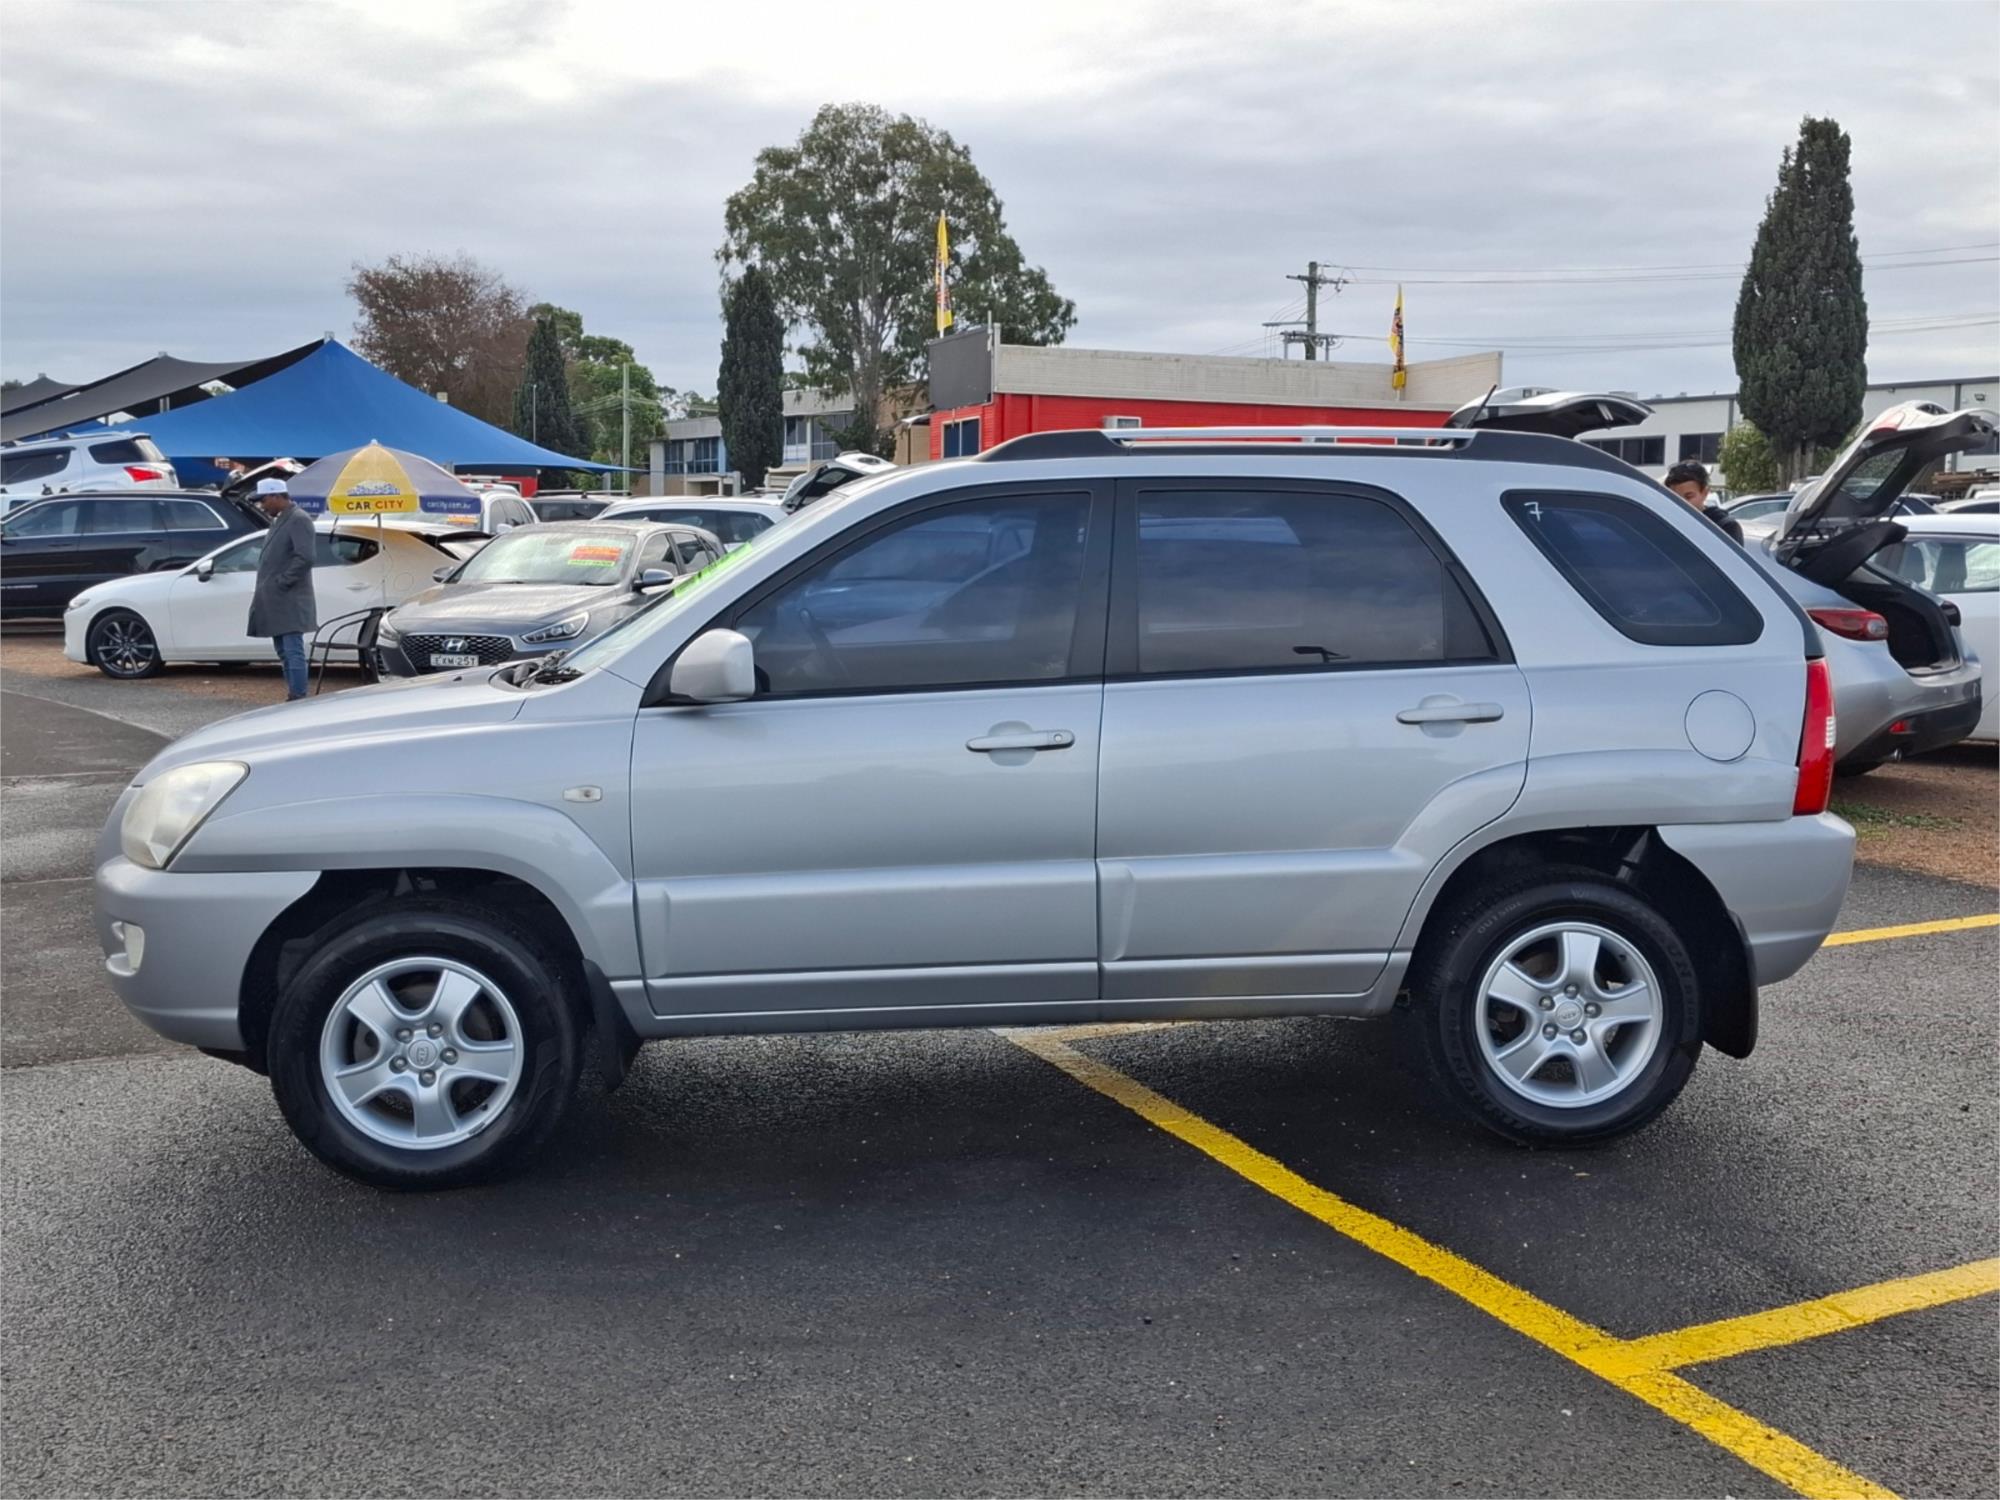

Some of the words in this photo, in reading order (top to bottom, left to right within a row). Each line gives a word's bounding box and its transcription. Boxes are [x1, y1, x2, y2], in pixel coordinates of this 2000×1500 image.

[346, 500, 370, 511] CAR
[374, 499, 403, 510] CITY
[1523, 501, 1544, 522] 7
